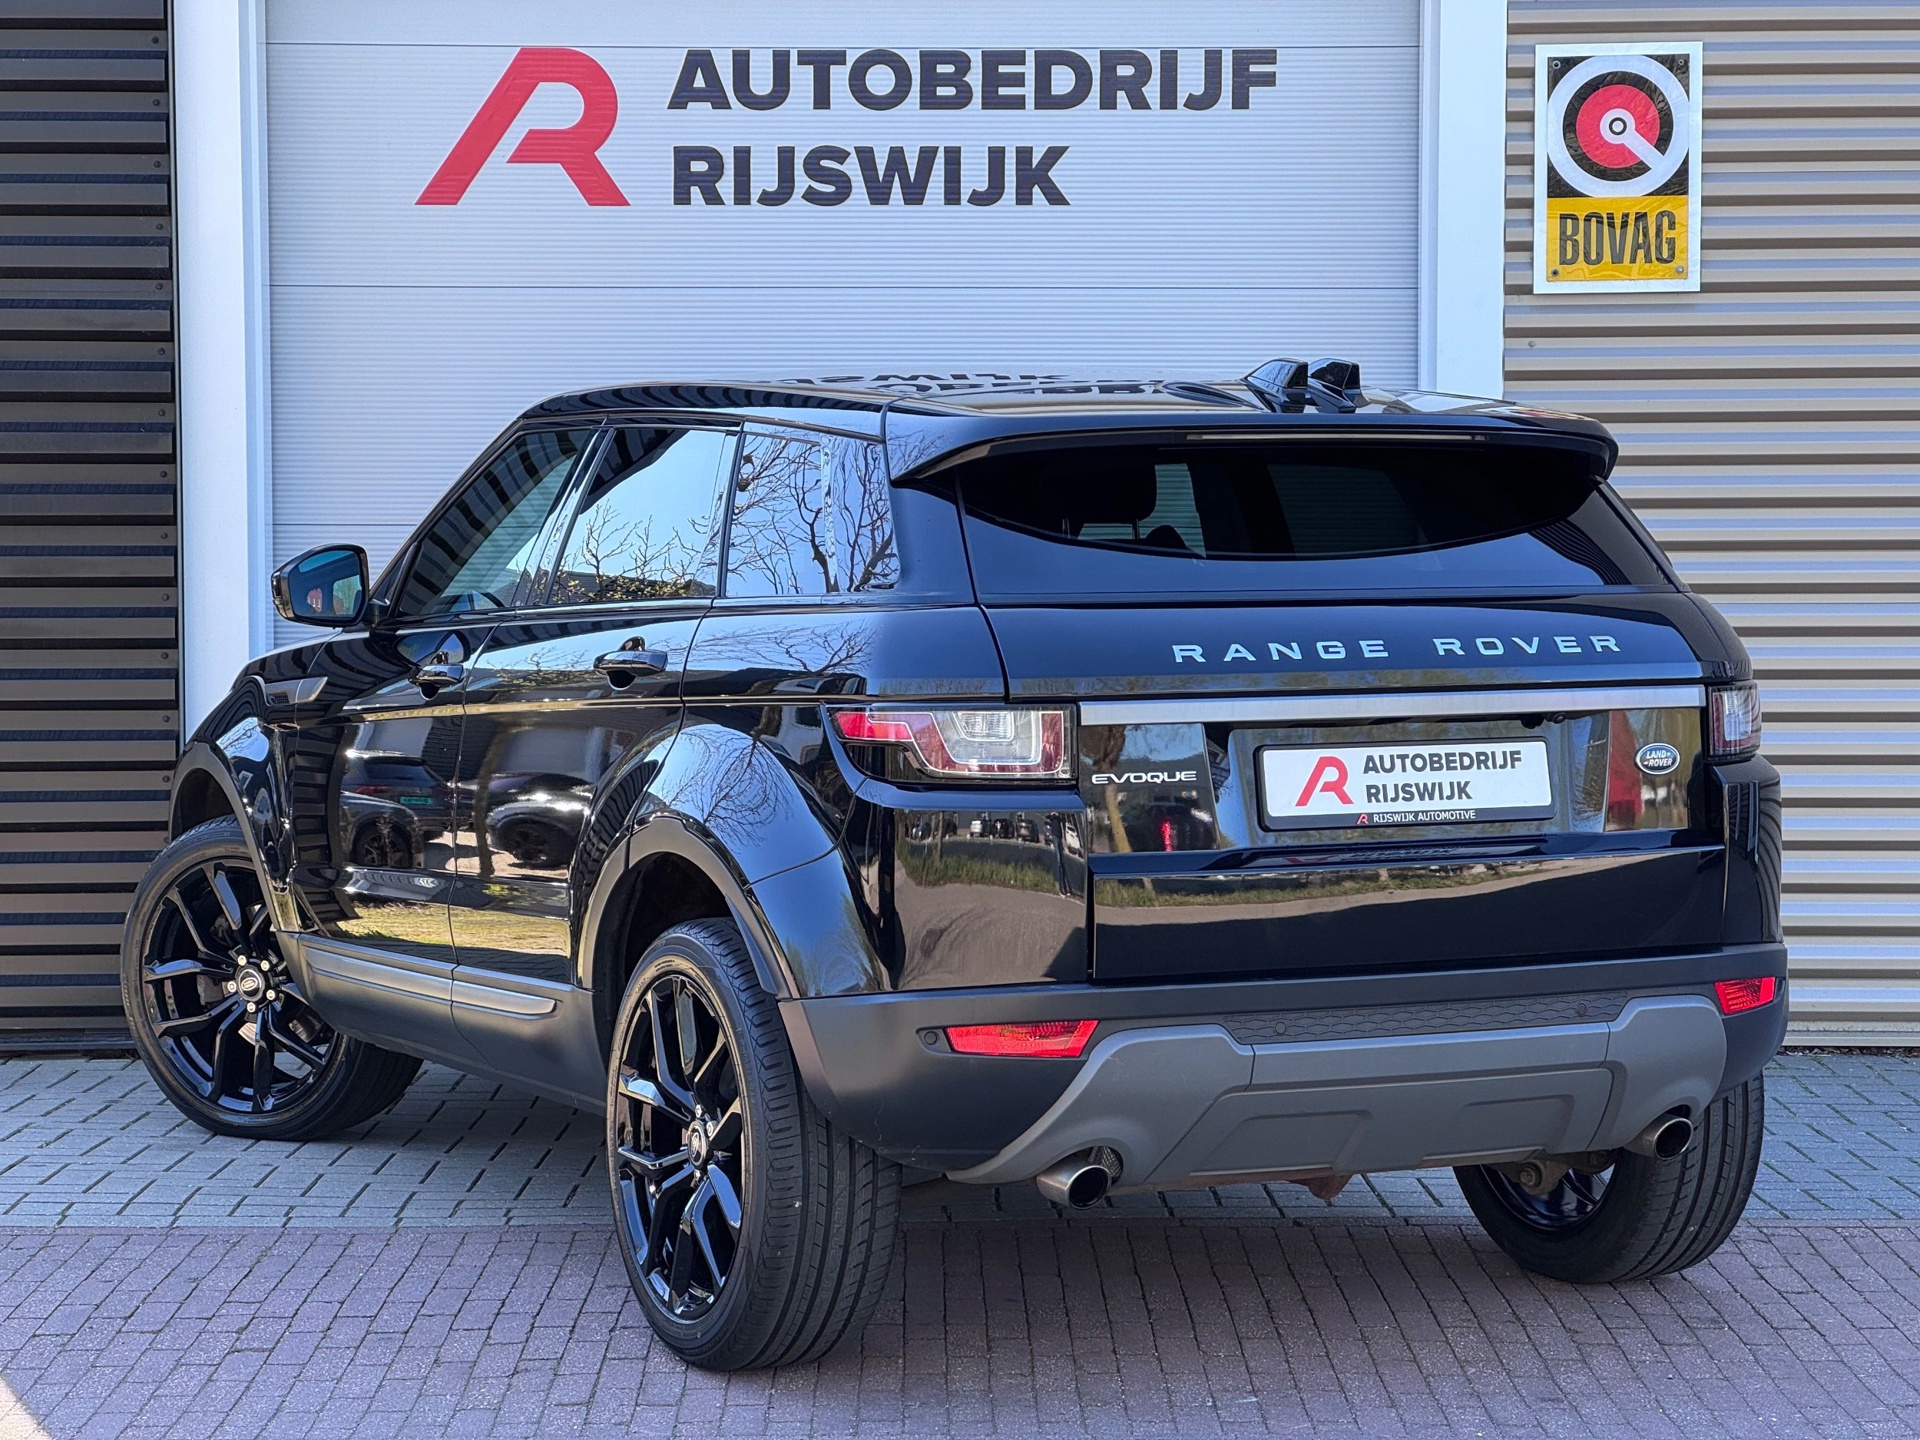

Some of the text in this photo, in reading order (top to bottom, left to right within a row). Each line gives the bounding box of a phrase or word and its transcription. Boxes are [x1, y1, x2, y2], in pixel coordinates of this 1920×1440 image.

[667, 48, 1278, 112] AUTOBEDRIJF
[672, 143, 1072, 207] RIJSWIJK
[1558, 210, 1677, 266] BOVAG
[1171, 635, 1621, 663] RANGE ROVER
[1363, 750, 1522, 775] AUTOBEDRIJF
[1646, 750, 1667, 759] LAND
[1648, 758, 1673, 767] ROVER
[1091, 770, 1197, 784] EVOQUE
[1365, 780, 1473, 804] RIJSWIJK
[1373, 810, 1476, 824] RIJSWIJK AUTOMOTIVE
